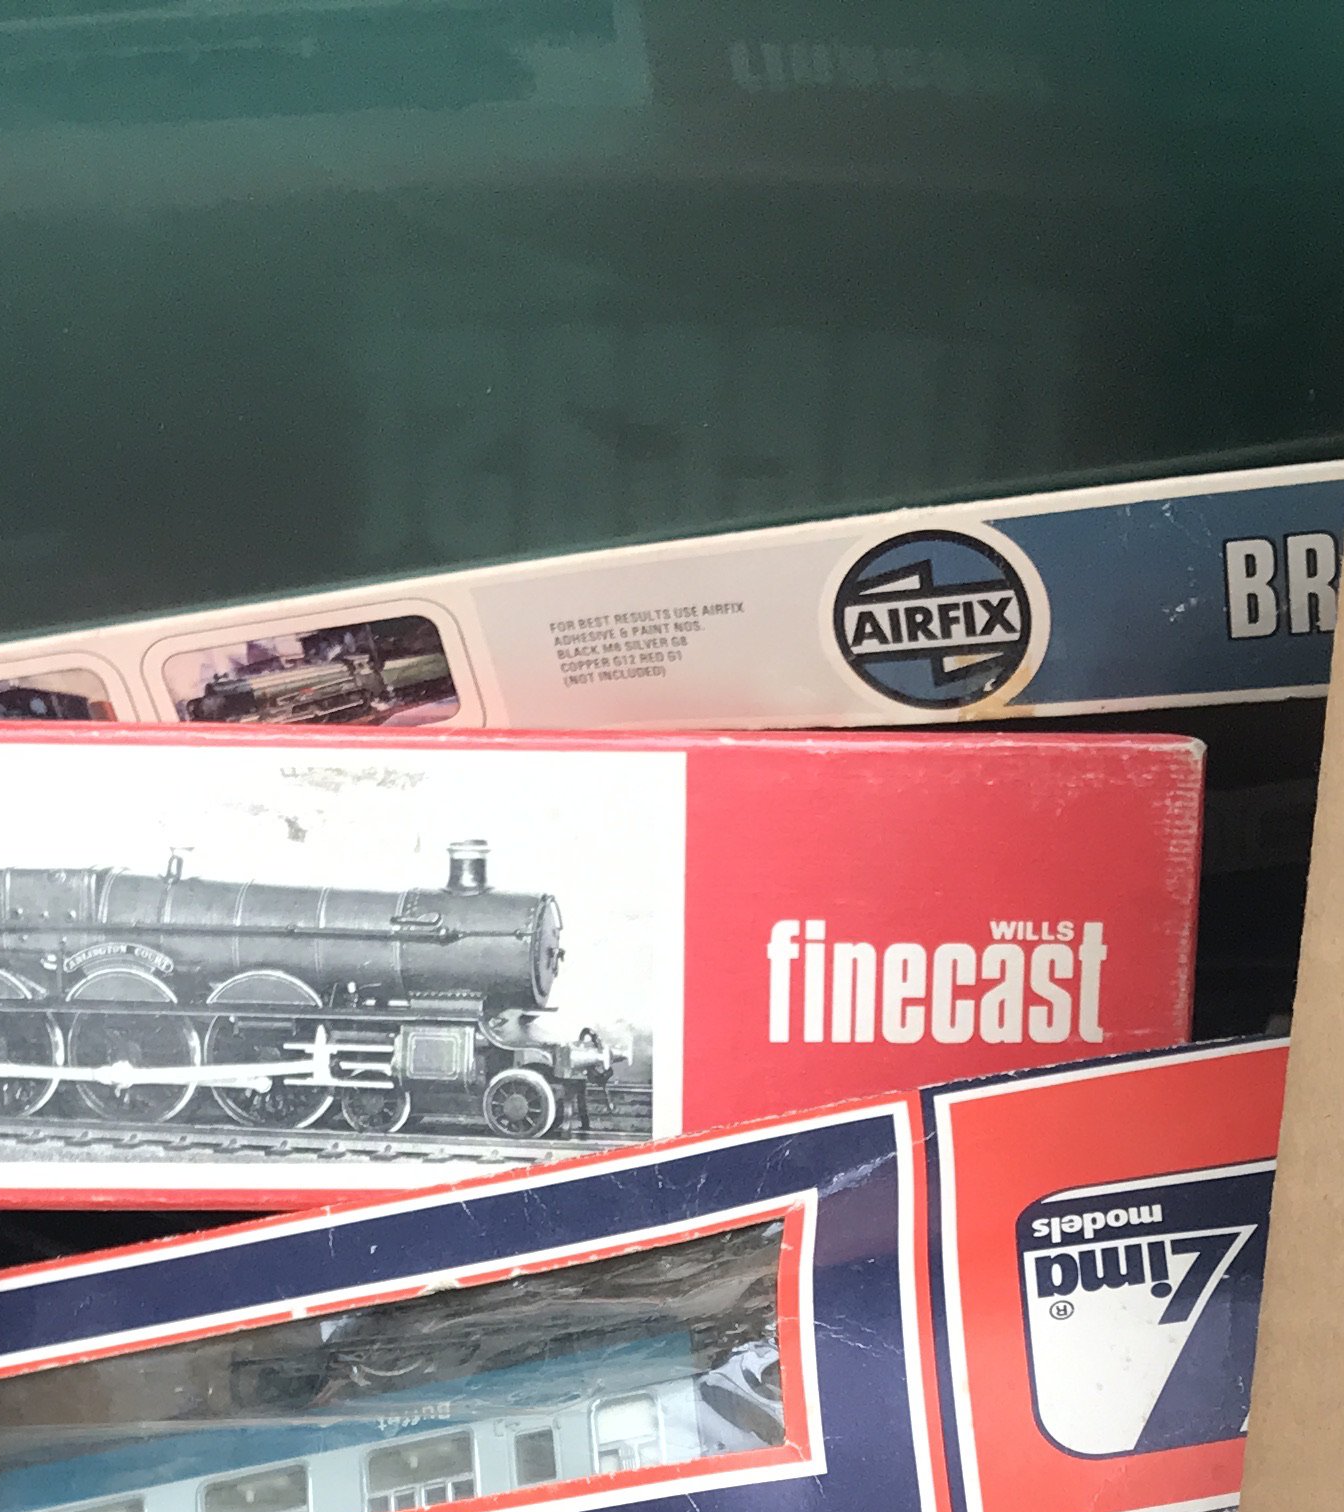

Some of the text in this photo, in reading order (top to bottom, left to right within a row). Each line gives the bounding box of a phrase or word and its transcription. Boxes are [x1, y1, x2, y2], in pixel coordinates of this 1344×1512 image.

[1224, 530, 1339, 641] BR
[549, 602, 744, 632] FOR BEST RESULTS USE AIRFIX
[850, 596, 1020, 649] AIRFIX
[552, 629, 615, 645] ADHESIVE
[632, 624, 670, 637] PAINT
[673, 620, 705, 633] NOS.
[556, 644, 597, 658] BLACK
[624, 637, 668, 652] SILVER
[559, 656, 609, 672] COPPER
[638, 651, 664, 664] RED
[563, 665, 665, 685] (NOT INCLUDED)
[989, 920, 1075, 941] WILLS
[767, 919, 1108, 1044] finecast
[1032, 1204, 1163, 1243] models
